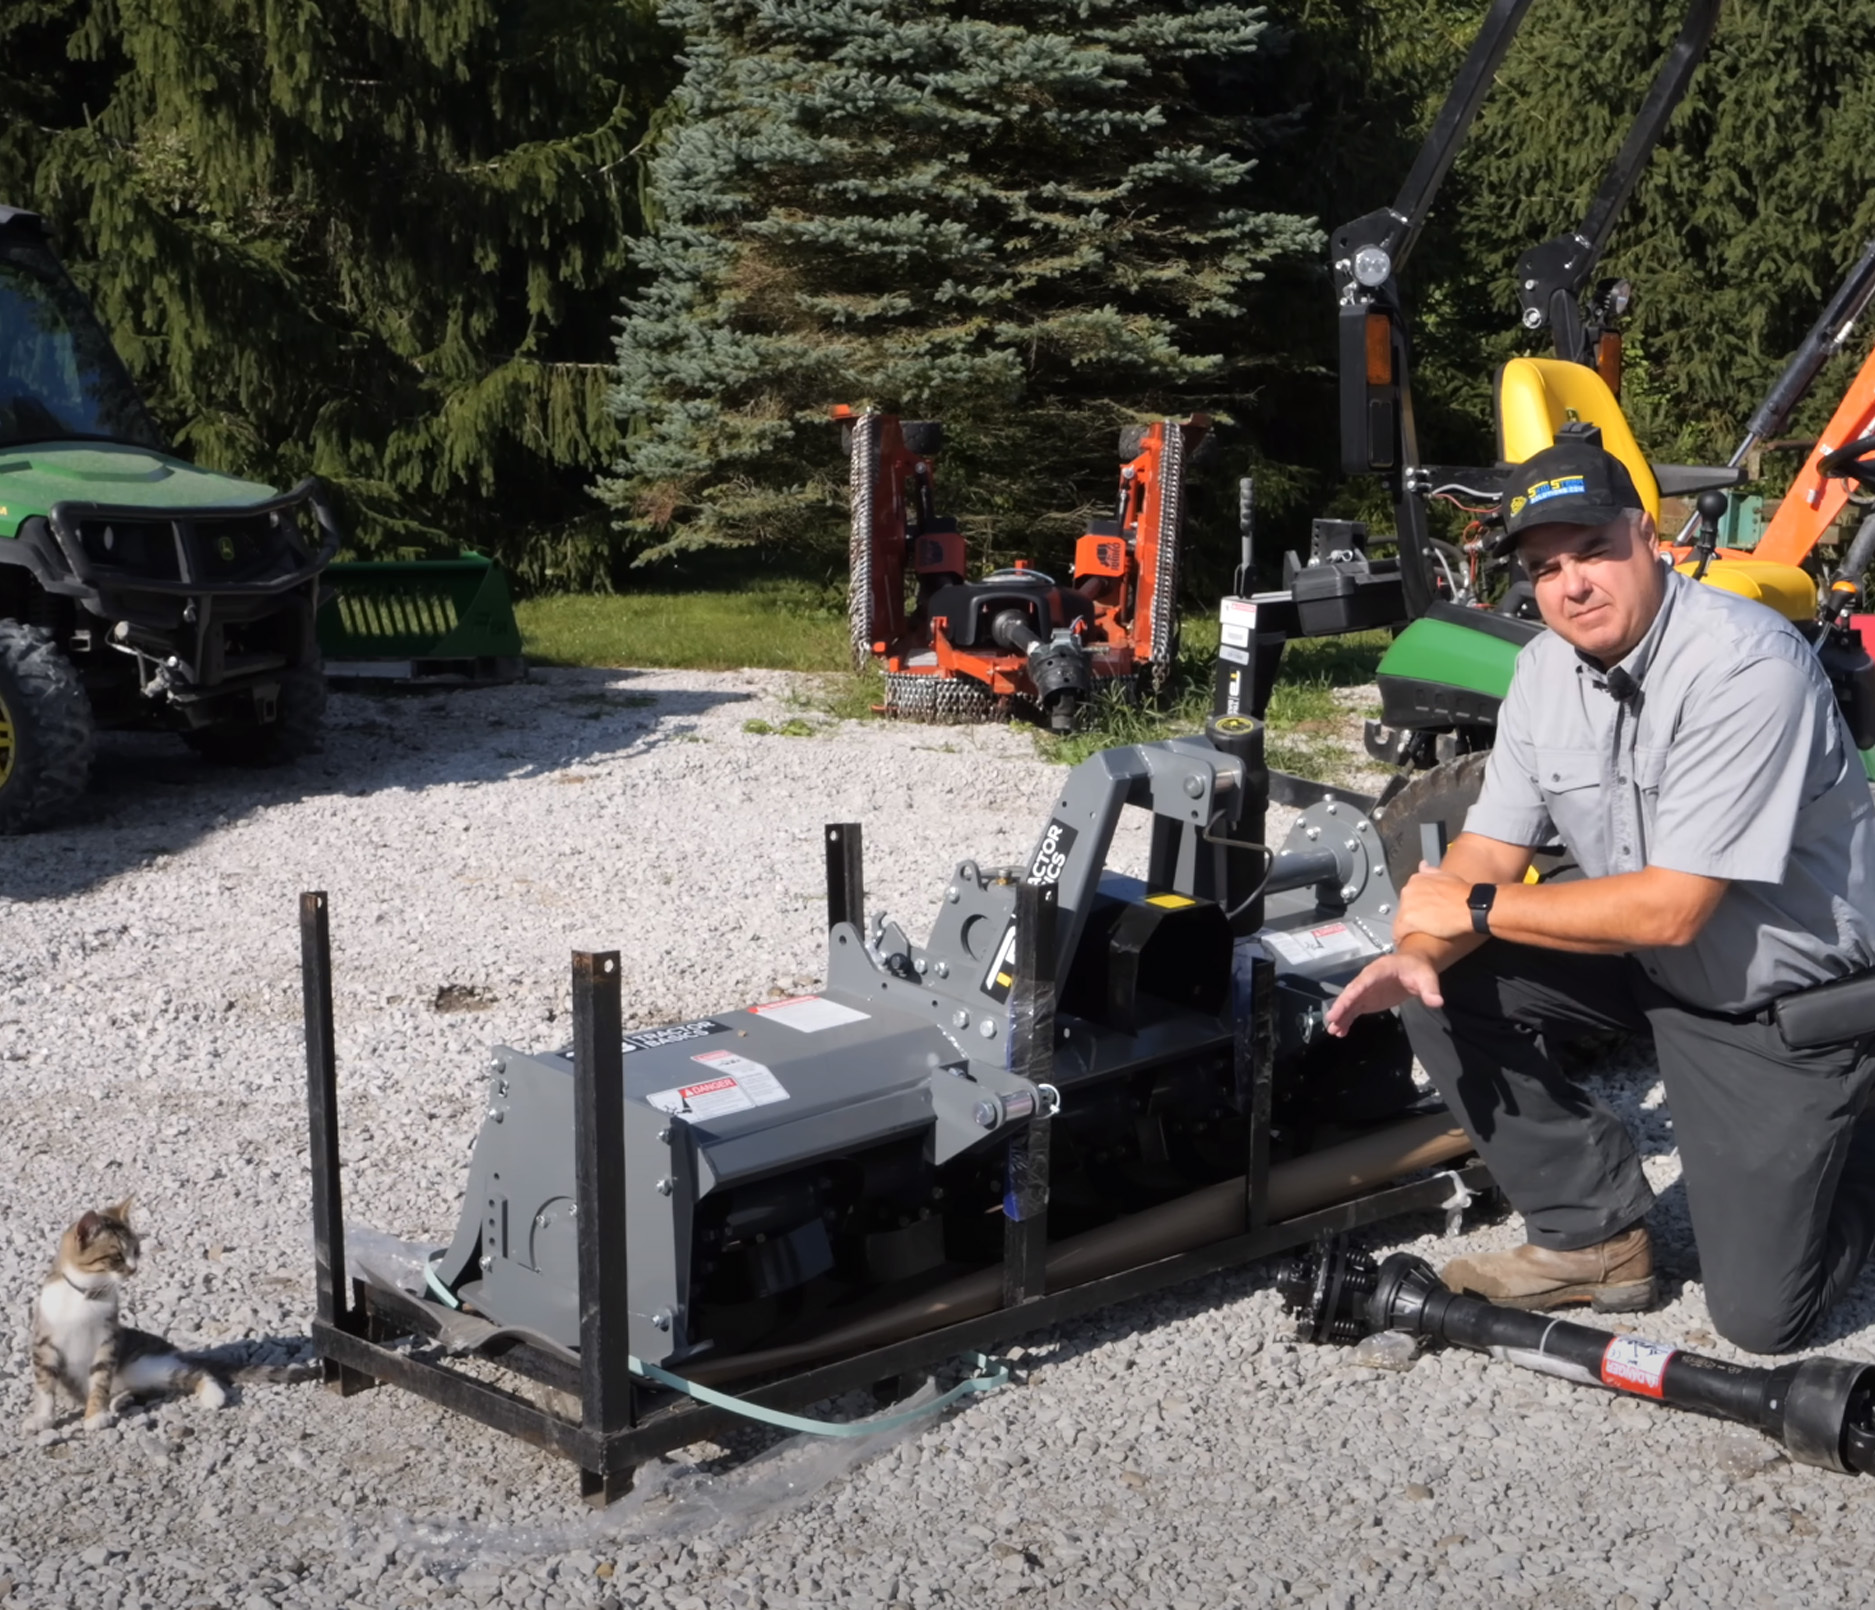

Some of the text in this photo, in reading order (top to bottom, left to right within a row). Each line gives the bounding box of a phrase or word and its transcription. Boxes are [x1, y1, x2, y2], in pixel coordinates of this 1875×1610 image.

[1027, 824, 1063, 886] ACTOR
[1041, 851, 1066, 885] ICS
[632, 1020, 716, 1042] TRACTOR
[643, 1029, 710, 1048] BASICS
[692, 1077, 734, 1095] DANGER
[1605, 1360, 1650, 1384] DANGER
